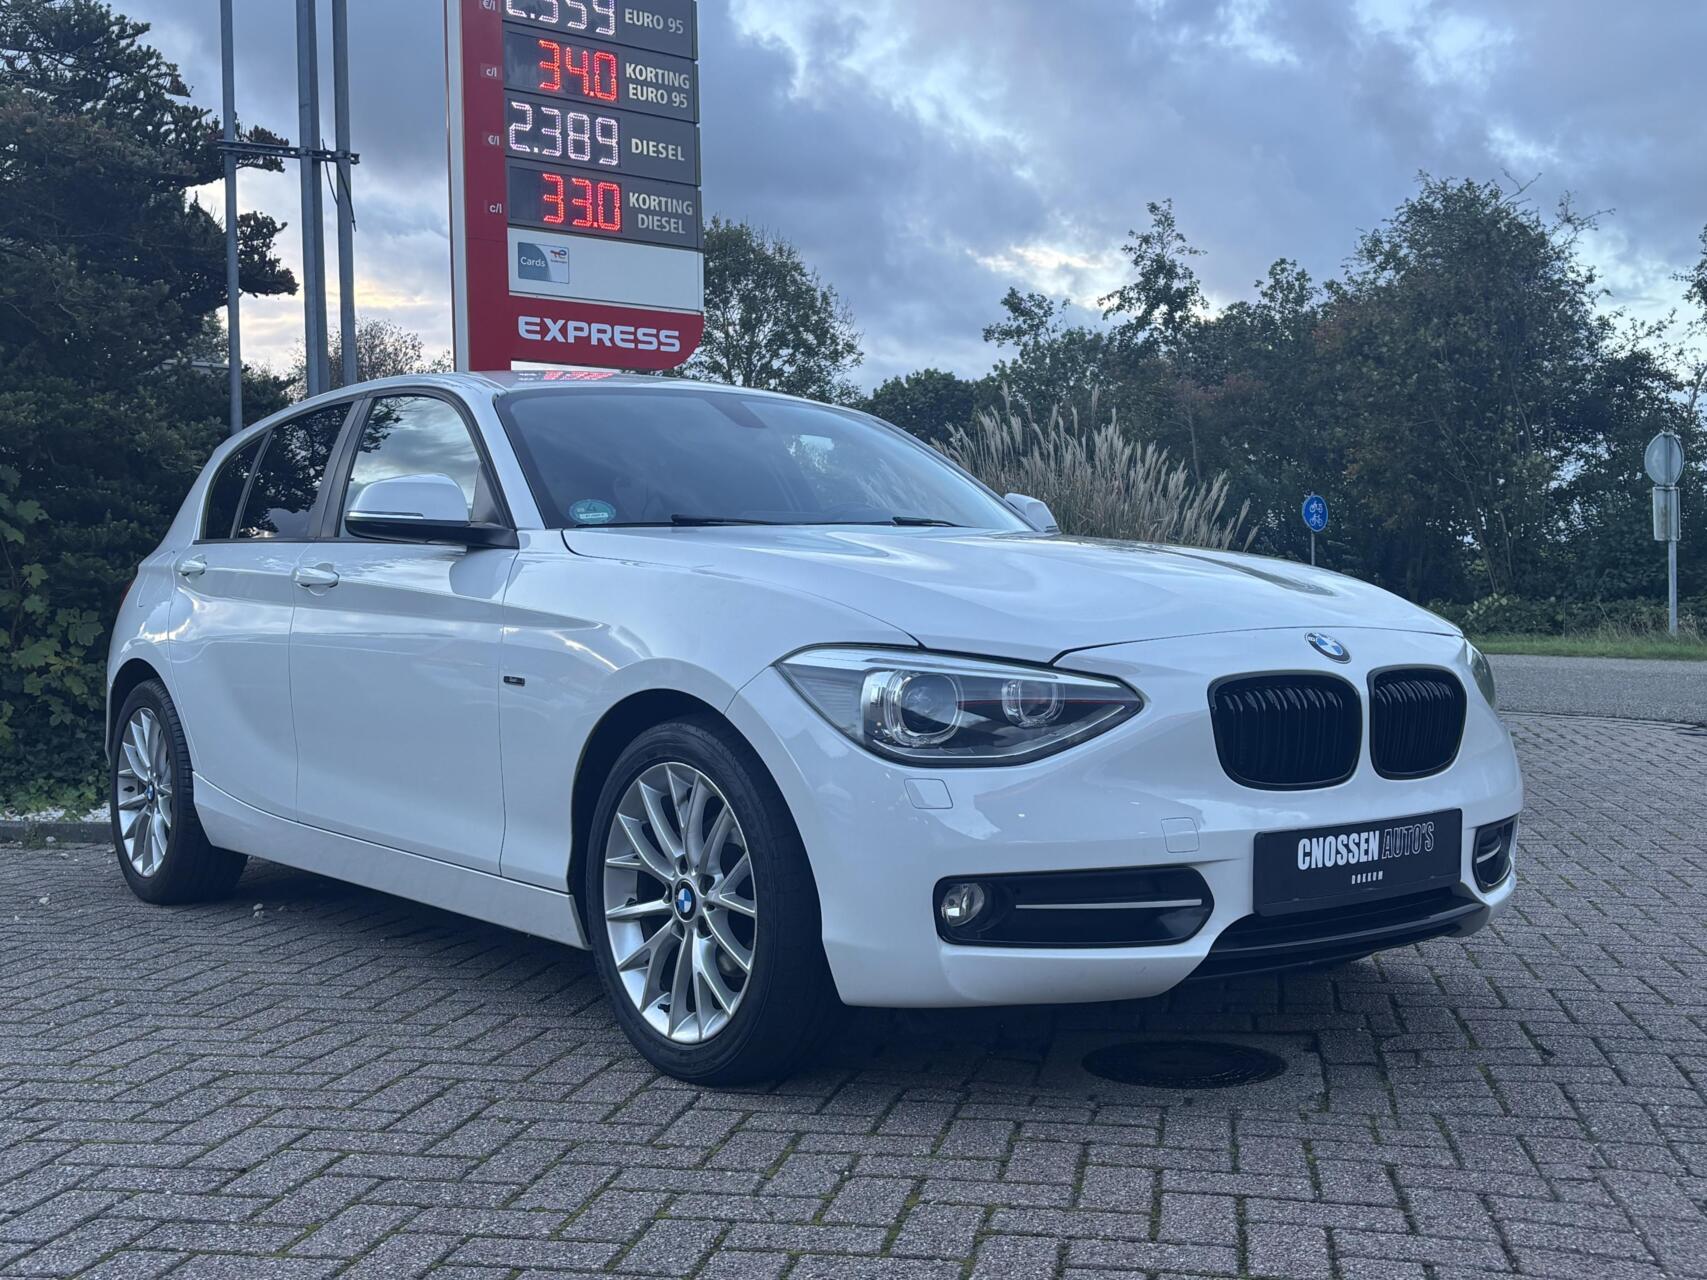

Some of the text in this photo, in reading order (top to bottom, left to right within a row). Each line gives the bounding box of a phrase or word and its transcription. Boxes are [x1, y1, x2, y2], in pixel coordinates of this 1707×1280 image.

[625, 8, 684, 34] EURO 95
[538, 39, 617, 100] 34.0
[625, 62, 690, 89] KORTING
[628, 84, 688, 108] EURO 95
[509, 101, 619, 166] 2.389
[631, 138, 685, 161] DIESEL
[542, 173, 621, 231] 33.0
[629, 192, 693, 216] KORTING
[638, 214, 686, 234] DIESEL
[520, 256, 546, 267] Cards
[517, 315, 681, 352] EXPRESS
[1297, 821, 1435, 871] CNOSSEN AUTO'S
